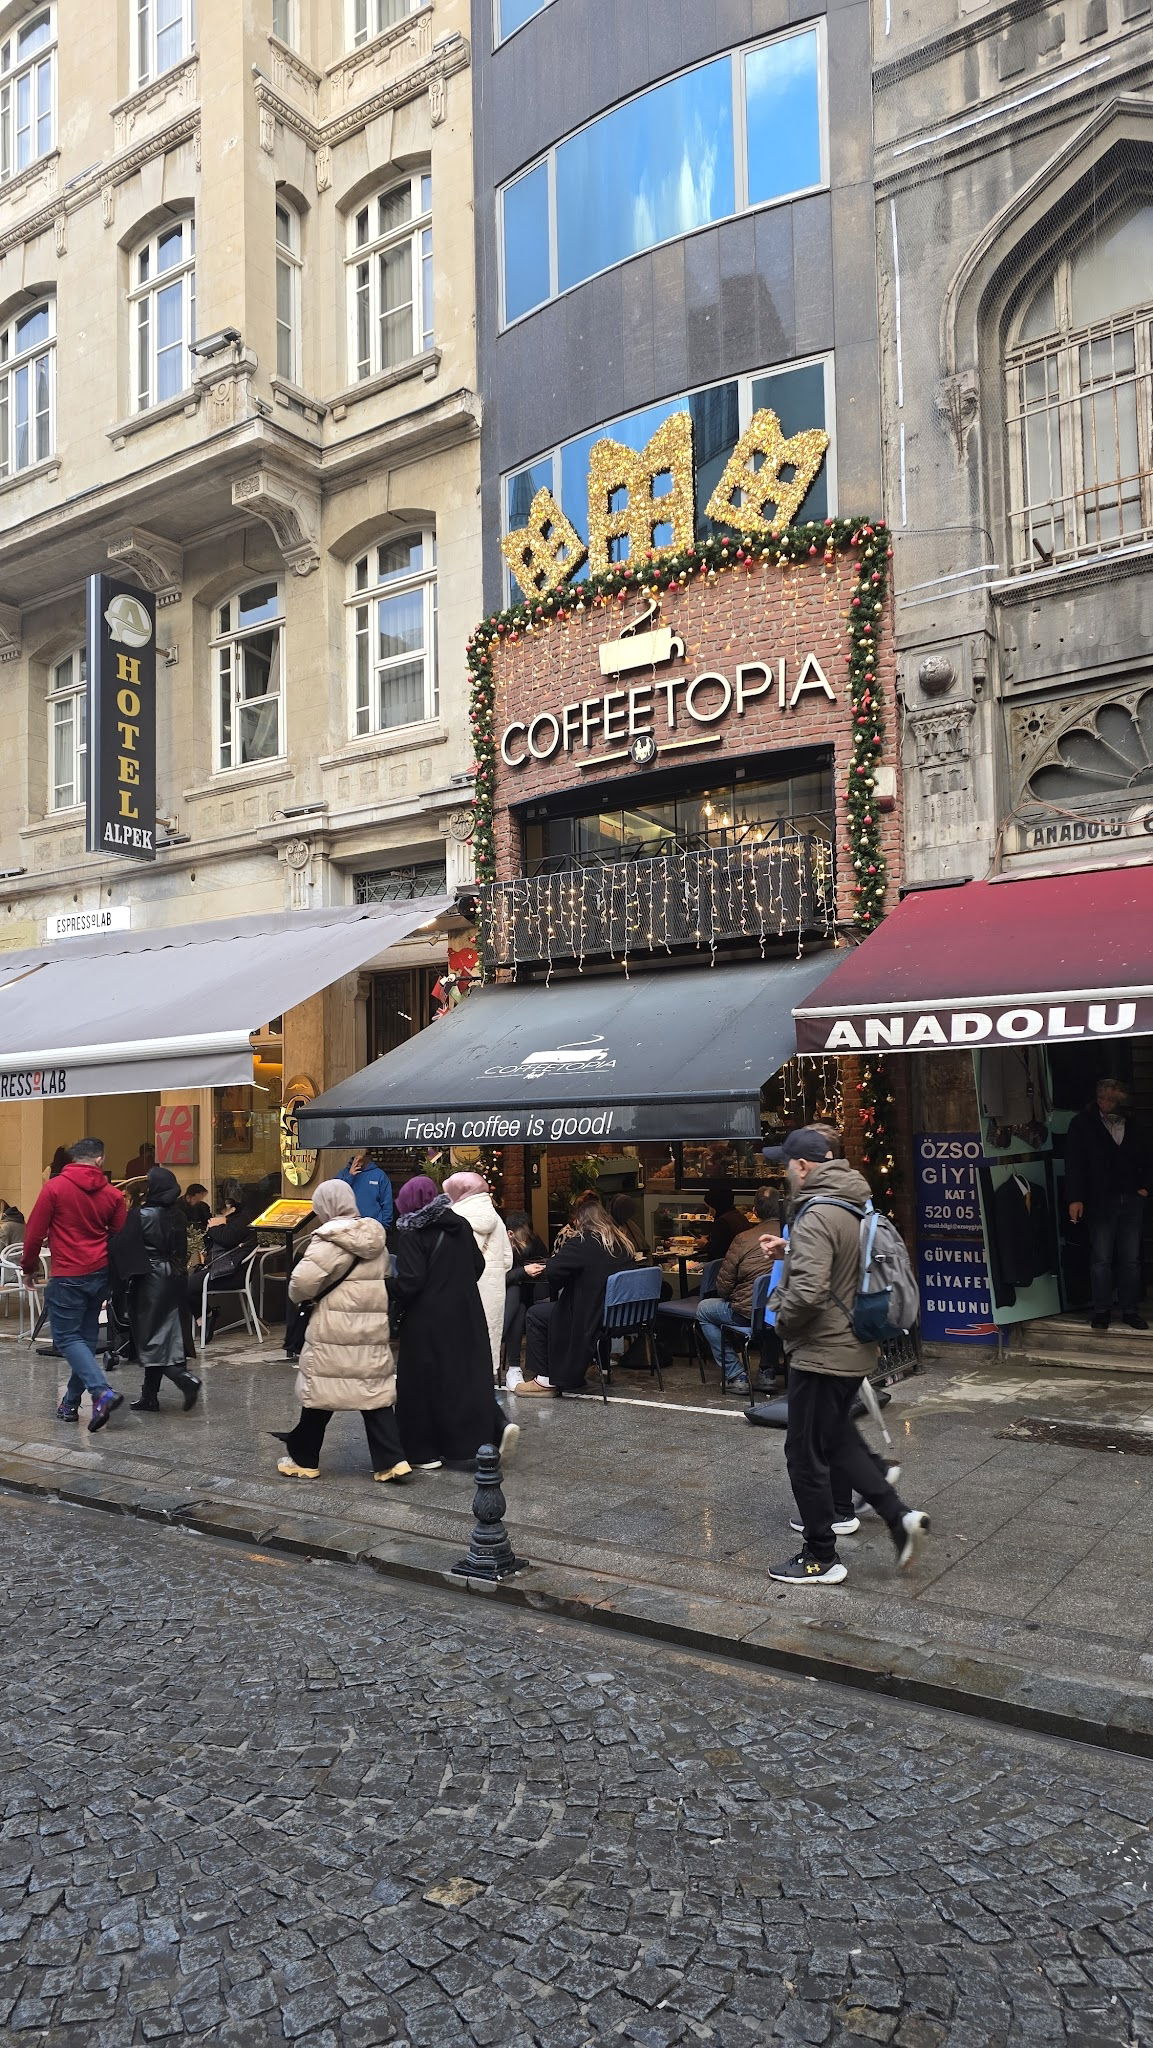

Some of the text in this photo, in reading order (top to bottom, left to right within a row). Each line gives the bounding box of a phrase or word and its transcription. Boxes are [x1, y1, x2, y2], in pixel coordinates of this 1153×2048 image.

[501, 653, 836, 766] COFFEETOPIA
[116, 653, 142, 819] HOTEL
[104, 821, 153, 850] ALPEK
[1033, 816, 1123, 847] ANADOLU
[824, 1002, 1137, 1049] ANADOLU
[484, 1059, 617, 1075] COFFEETOPIA
[404, 1111, 614, 1140] Fresh coffee is good!
[920, 1139, 983, 1159] ÖZSO
[945, 1190, 976, 1200] KAT 1
[925, 1206, 952, 1219] 520
[956, 1206, 974, 1219] 05
[927, 1299, 990, 1315] BULUNU
